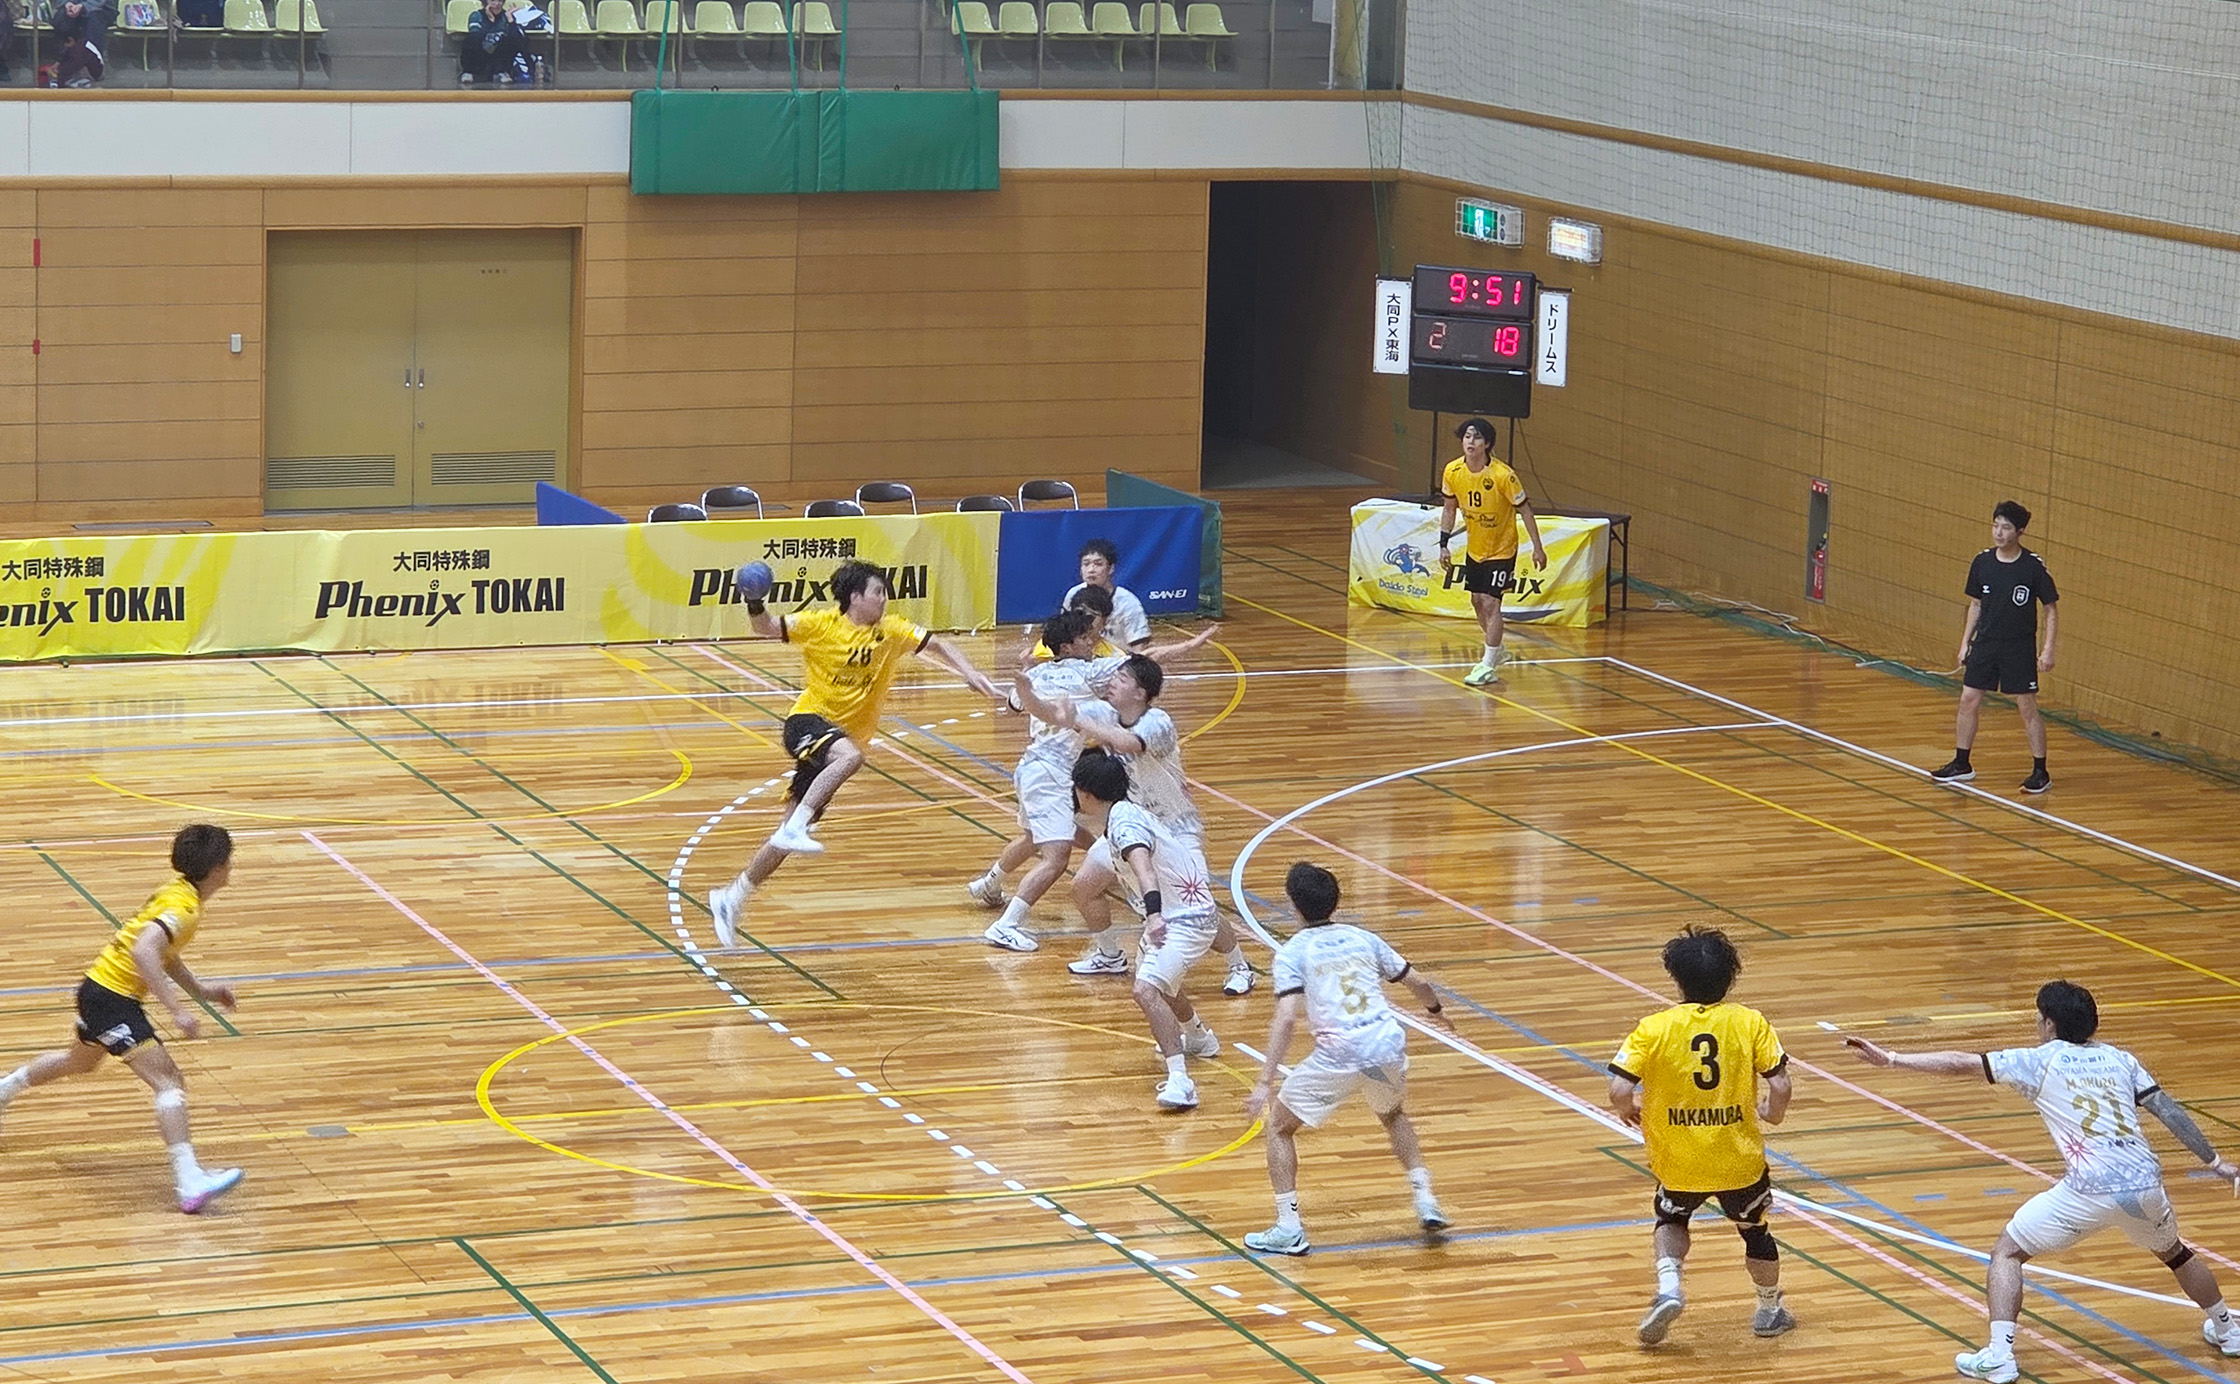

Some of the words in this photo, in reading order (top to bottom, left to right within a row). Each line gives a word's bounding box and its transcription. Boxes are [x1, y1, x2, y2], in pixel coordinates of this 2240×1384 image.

[1449, 273, 1522, 306] 9:51
[1385, 293, 1401, 362] 大同PX東海
[1493, 326, 1520, 356] 18
[1545, 304, 1559, 373] ドリームス
[1468, 490, 1482, 507] 19
[393, 549, 491, 572] 大同特殊鋼
[763, 537, 857, 560] 大同特殊鋼
[2, 556, 105, 581] 大同特殊鋼
[1491, 570, 1506, 587] 19
[84, 586, 185, 623] TOKAI
[315, 579, 466, 627] Phenix
[471, 577, 565, 615] TOKAI
[688, 567, 831, 613] Phnix
[1406, 584, 1429, 596] Steel
[1340, 971, 1368, 1015] 5
[1690, 1033, 1721, 1090] 3
[1668, 1104, 1743, 1127] NAKAMURA
[2071, 1089, 2134, 1138] 21
